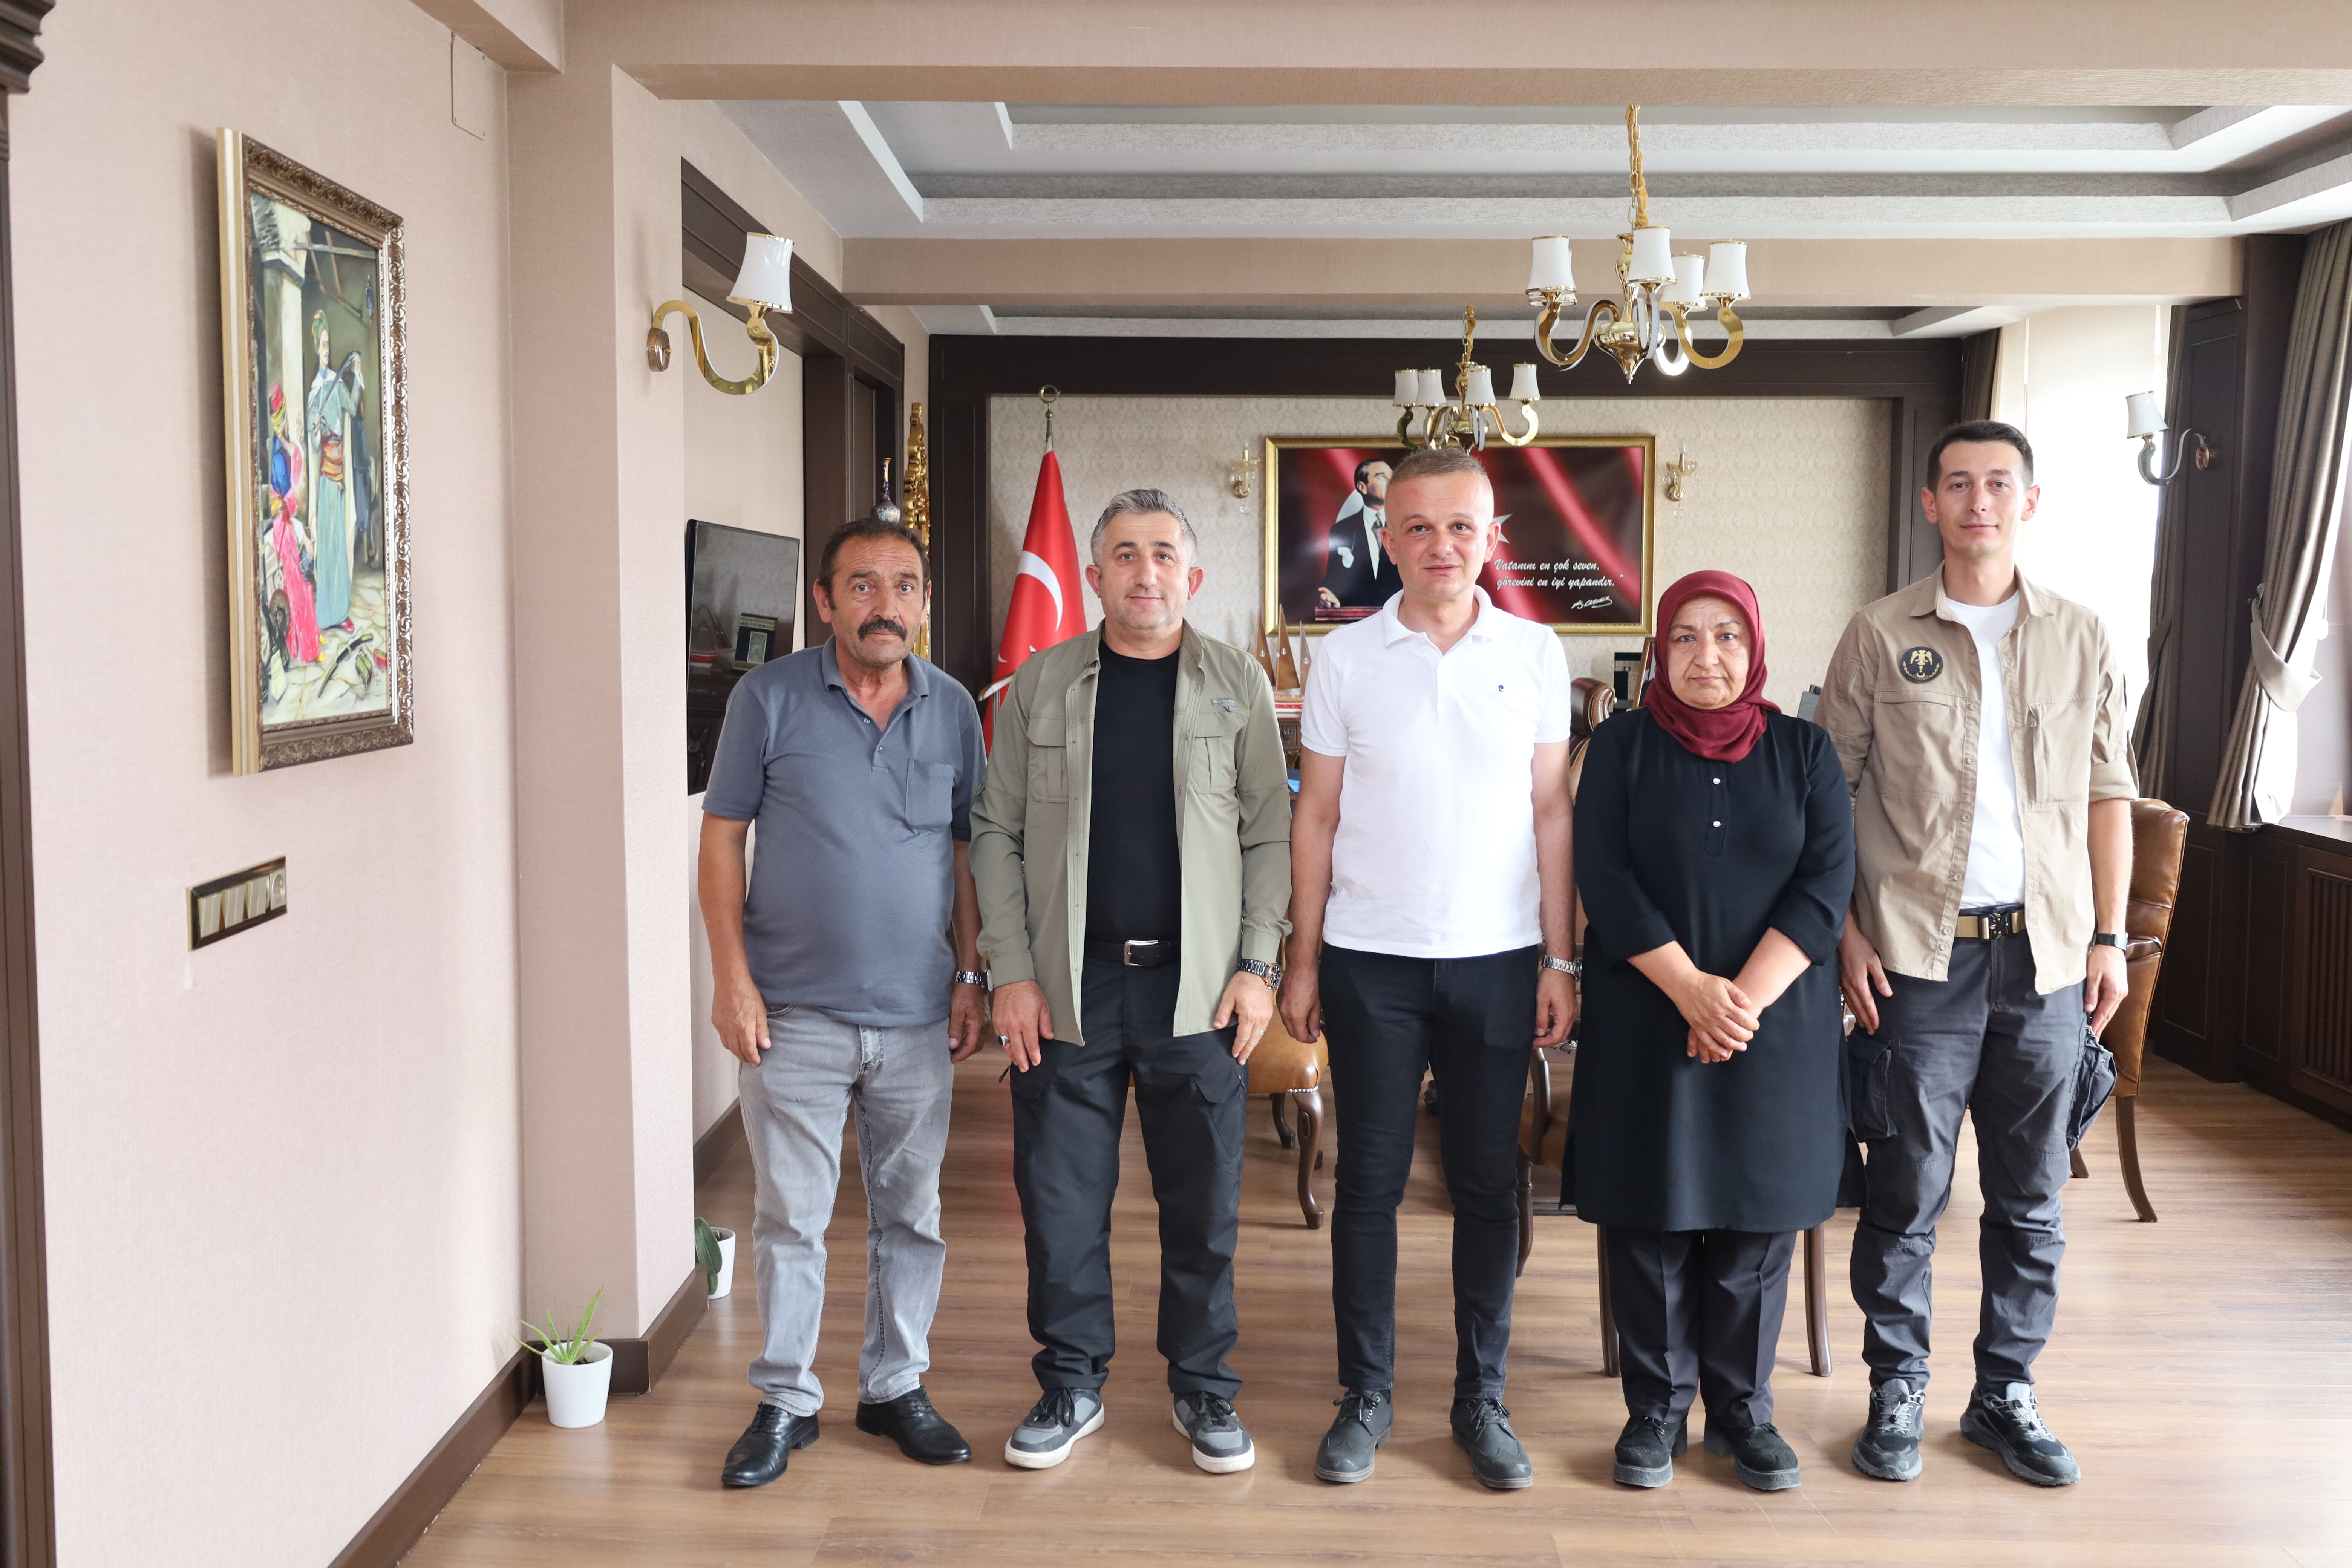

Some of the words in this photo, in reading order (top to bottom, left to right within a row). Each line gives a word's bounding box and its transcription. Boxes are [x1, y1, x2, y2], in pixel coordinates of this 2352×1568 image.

[1494, 559, 1536, 570] Vatanını
[1554, 559, 1570, 573] çok
[1497, 576, 1534, 590] görevini
[1551, 577, 1565, 590] iyi
